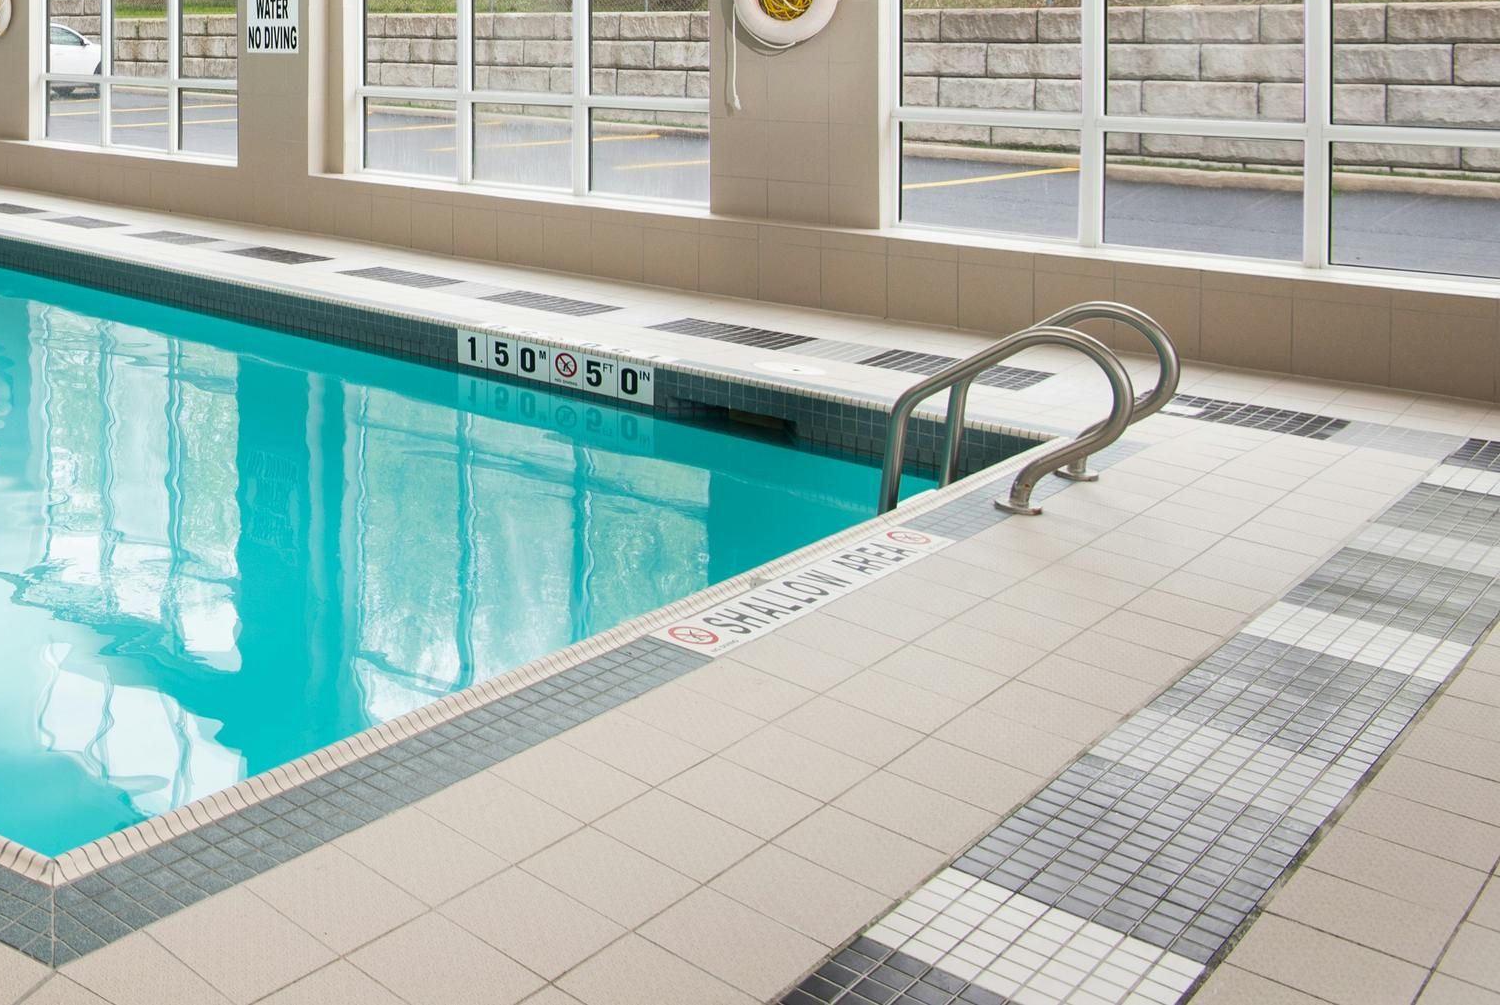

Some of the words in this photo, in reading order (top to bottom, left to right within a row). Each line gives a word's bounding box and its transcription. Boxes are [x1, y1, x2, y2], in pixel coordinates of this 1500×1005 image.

[248, 26, 261, 49] NO
[264, 26, 297, 49] DIVING
[702, 569, 852, 634] SHALLOW
[831, 542, 918, 575] AREA
